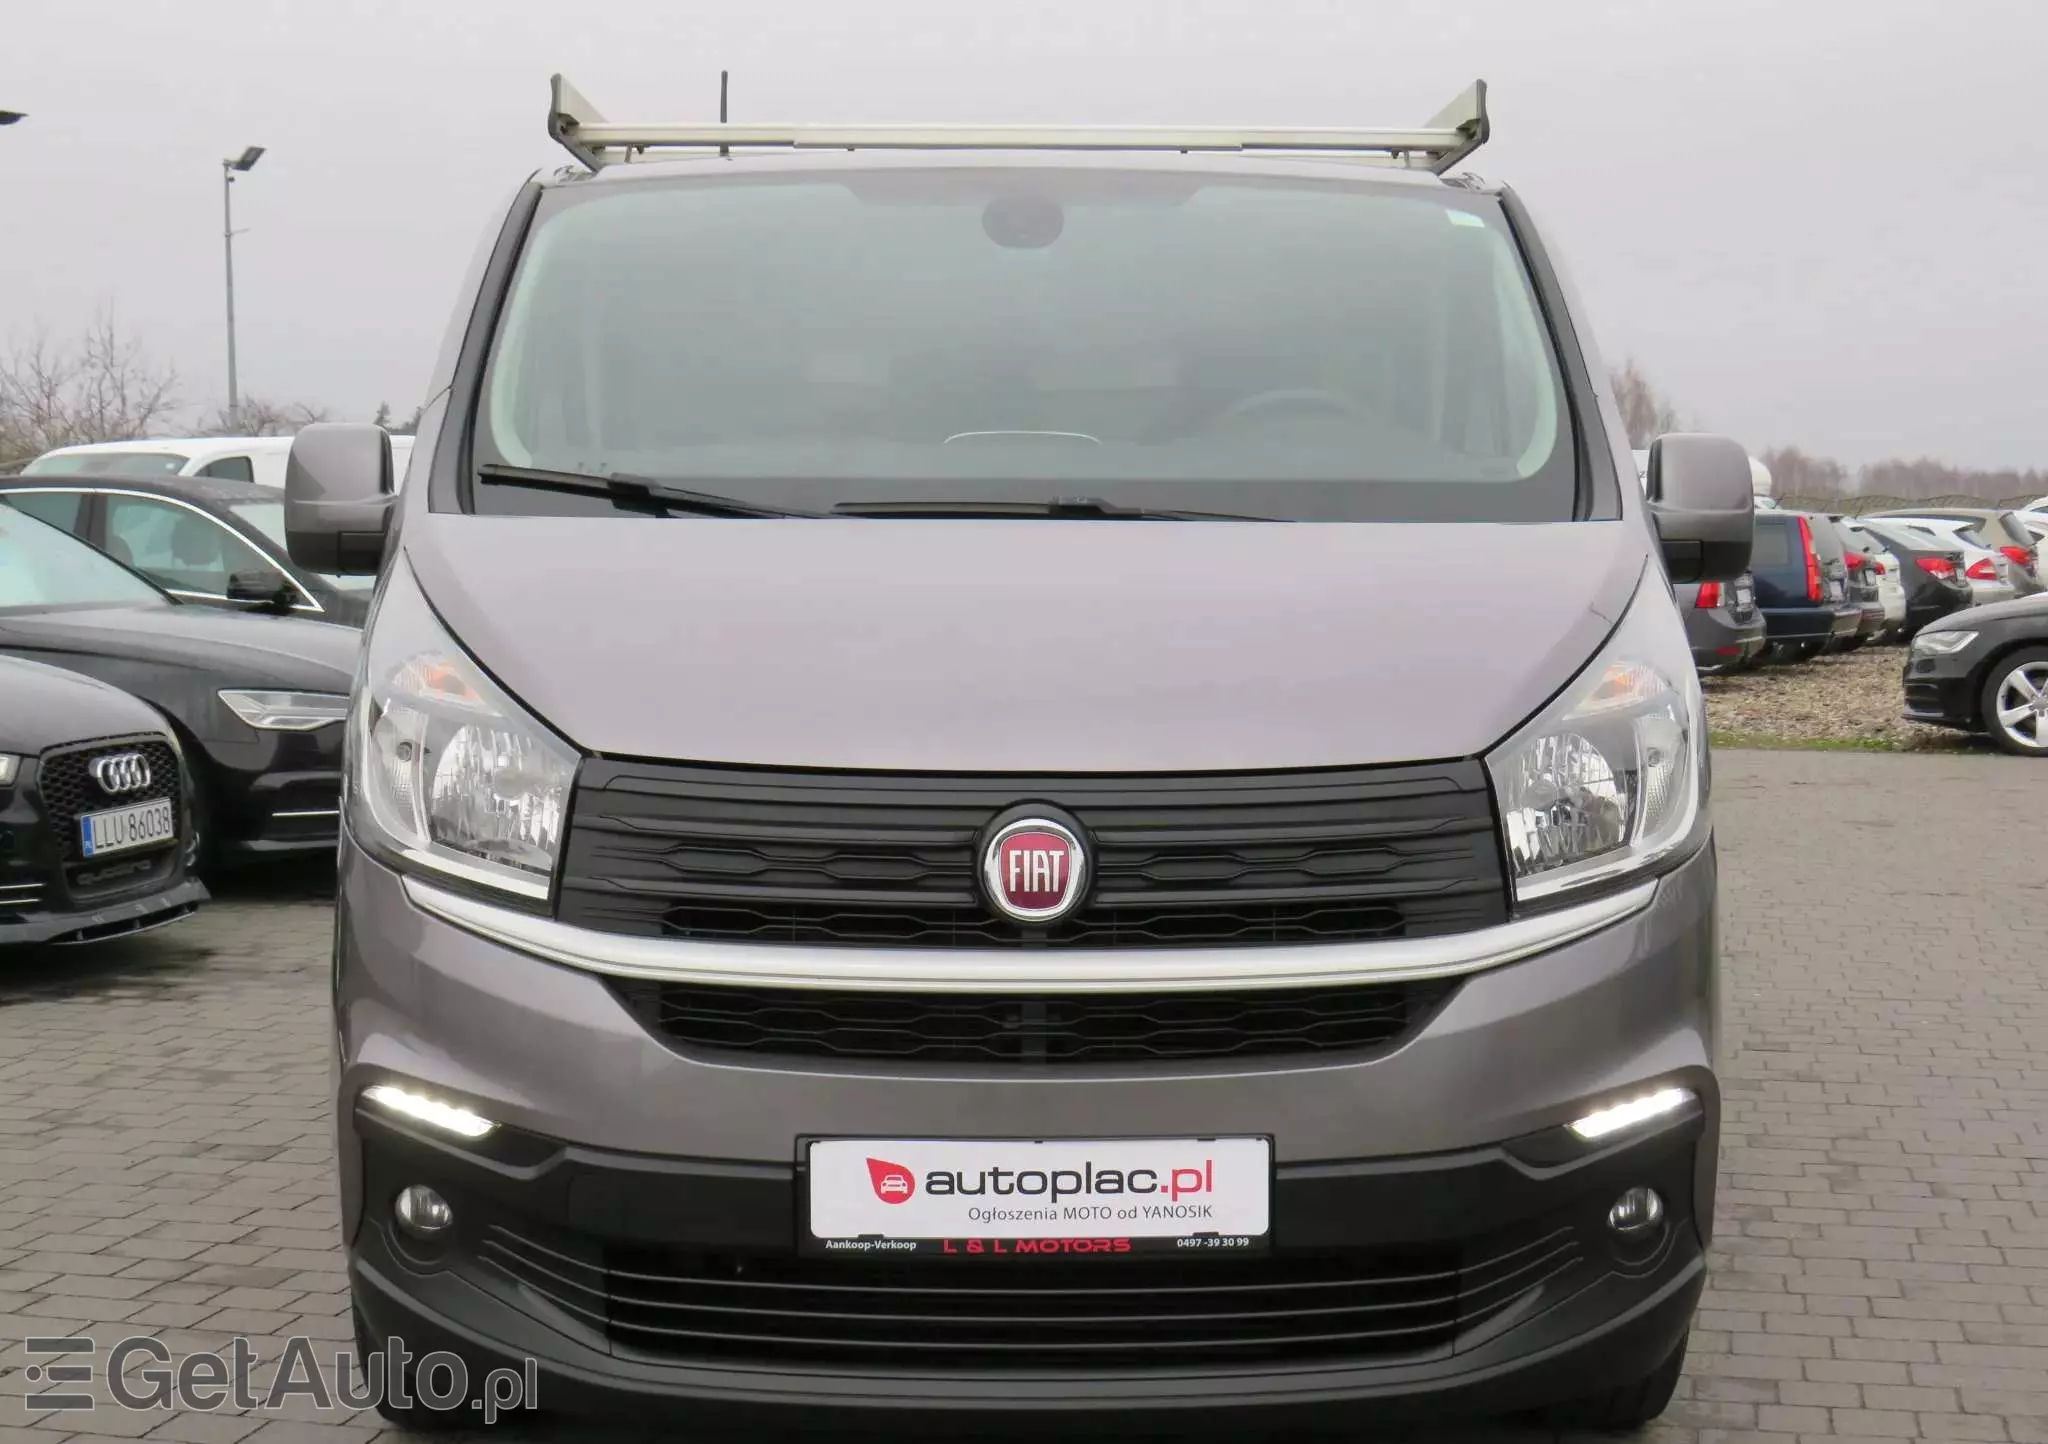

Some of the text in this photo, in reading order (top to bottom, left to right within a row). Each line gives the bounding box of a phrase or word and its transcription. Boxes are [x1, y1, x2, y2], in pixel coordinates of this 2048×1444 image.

[94, 806, 170, 849] LLU 86038
[1009, 850, 1065, 892] FIAT
[925, 1160, 1212, 1203] autoplac.pl
[968, 1204, 1213, 1224] Ogłoszenia MOTO od YANOSIK
[825, 1239, 917, 1252] Aankoop-Verkoop
[943, 1237, 1132, 1253] L & L MOTORS
[1177, 1237, 1201, 1248] 0497
[1221, 1236, 1235, 1247] 30
[1236, 1236, 1250, 1247] 99
